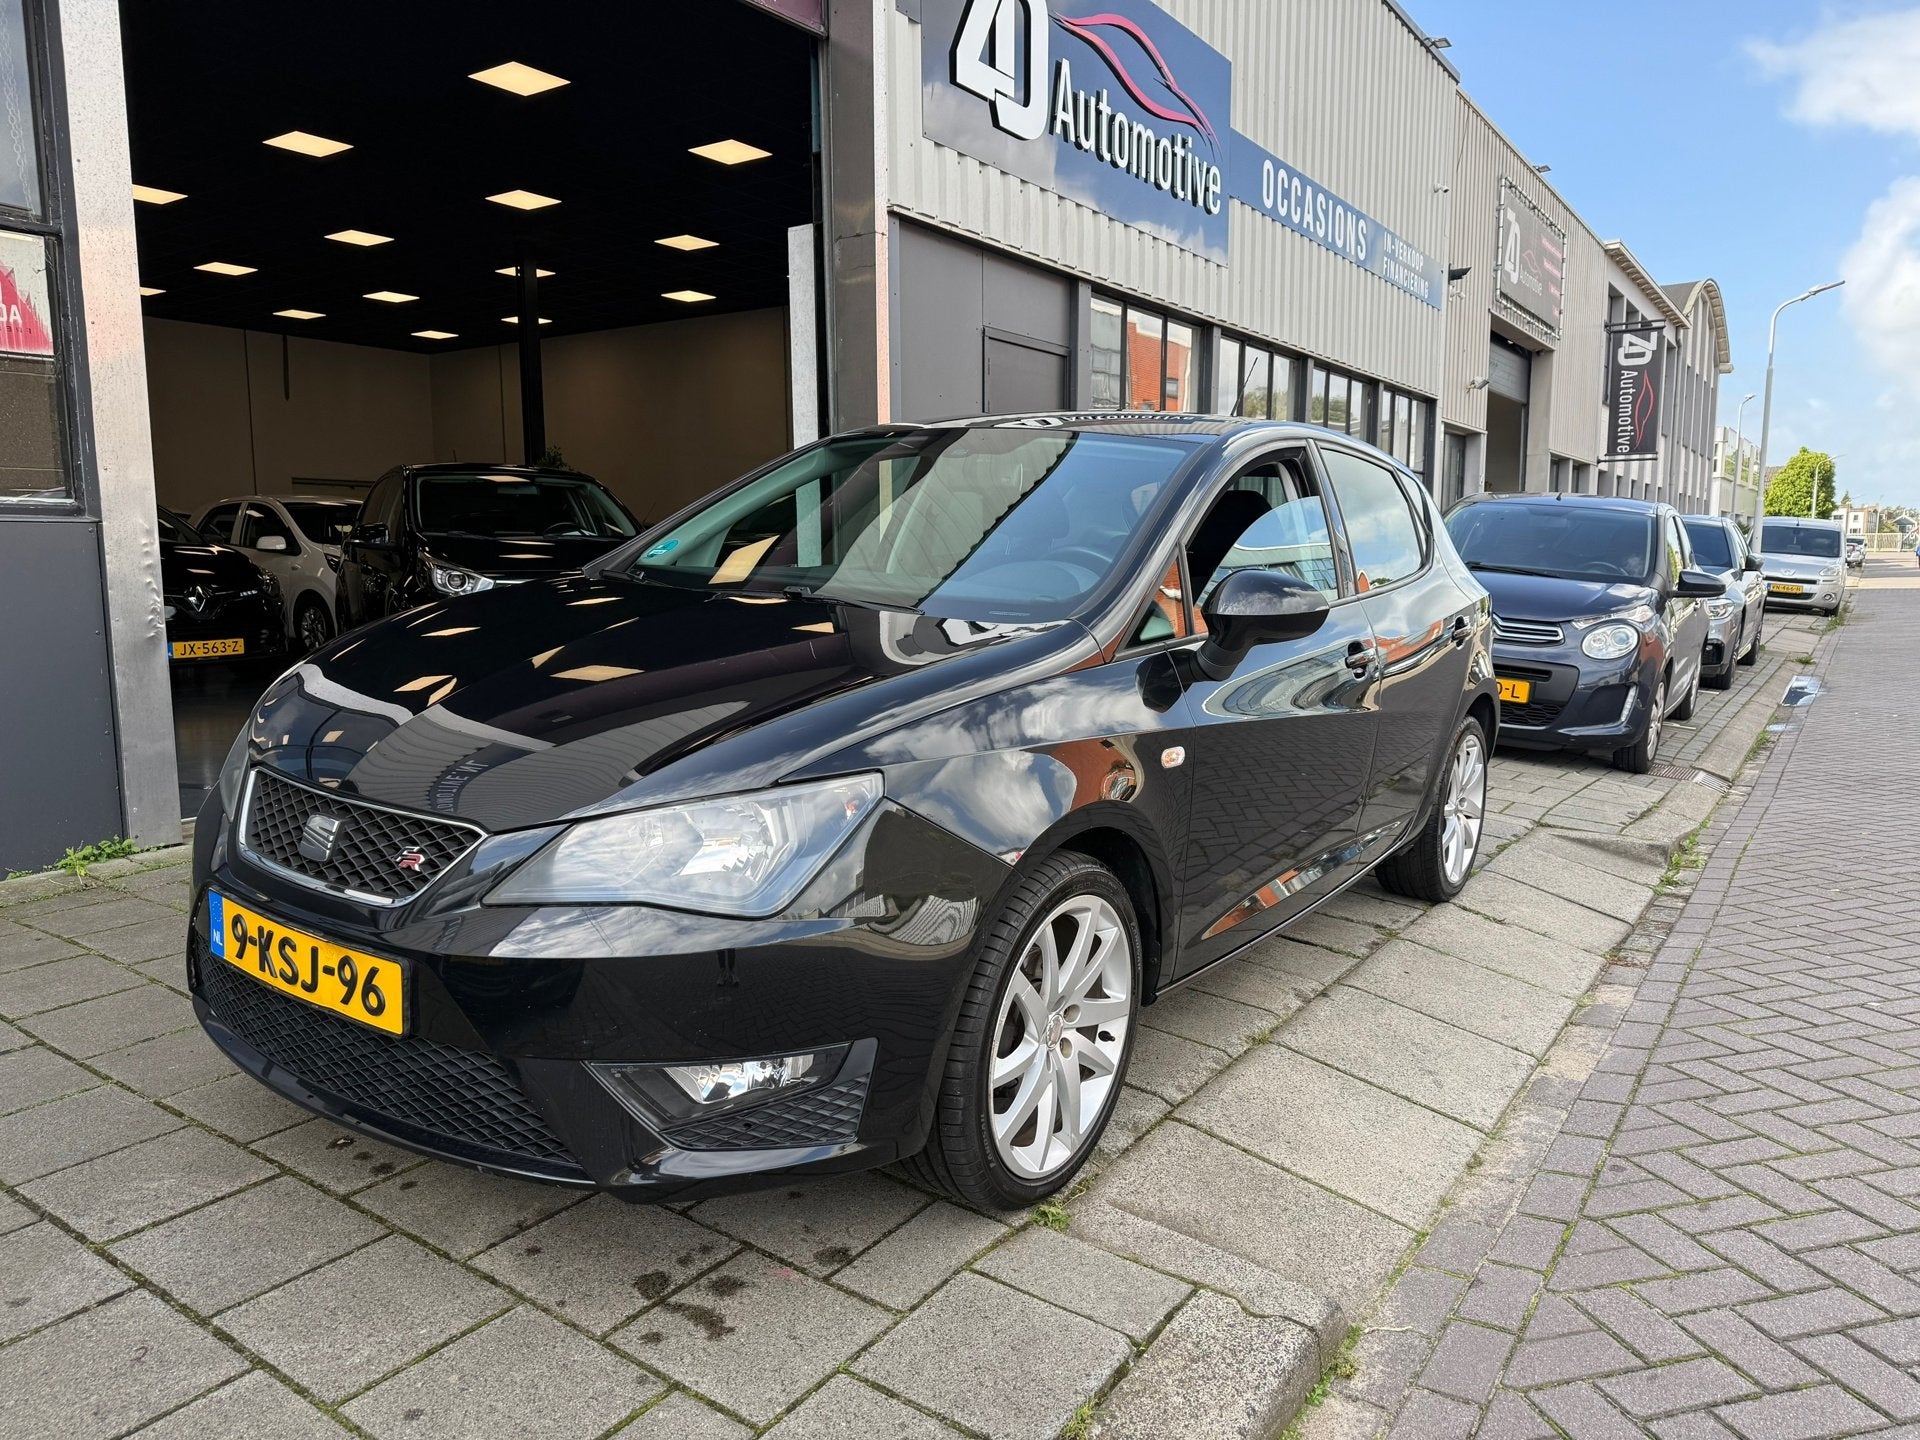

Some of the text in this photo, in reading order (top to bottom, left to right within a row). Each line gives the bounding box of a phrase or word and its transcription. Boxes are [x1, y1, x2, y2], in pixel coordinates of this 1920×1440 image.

[1052, 58, 1221, 214] Automotive
[1263, 159, 1367, 261] OCCASIONS
[1382, 256, 1429, 299] FINANCIERING
[1616, 370, 1639, 453] Automotive
[180, 640, 239, 656] JX-563-Z
[231, 913, 386, 1017] 9-KSJ-96
